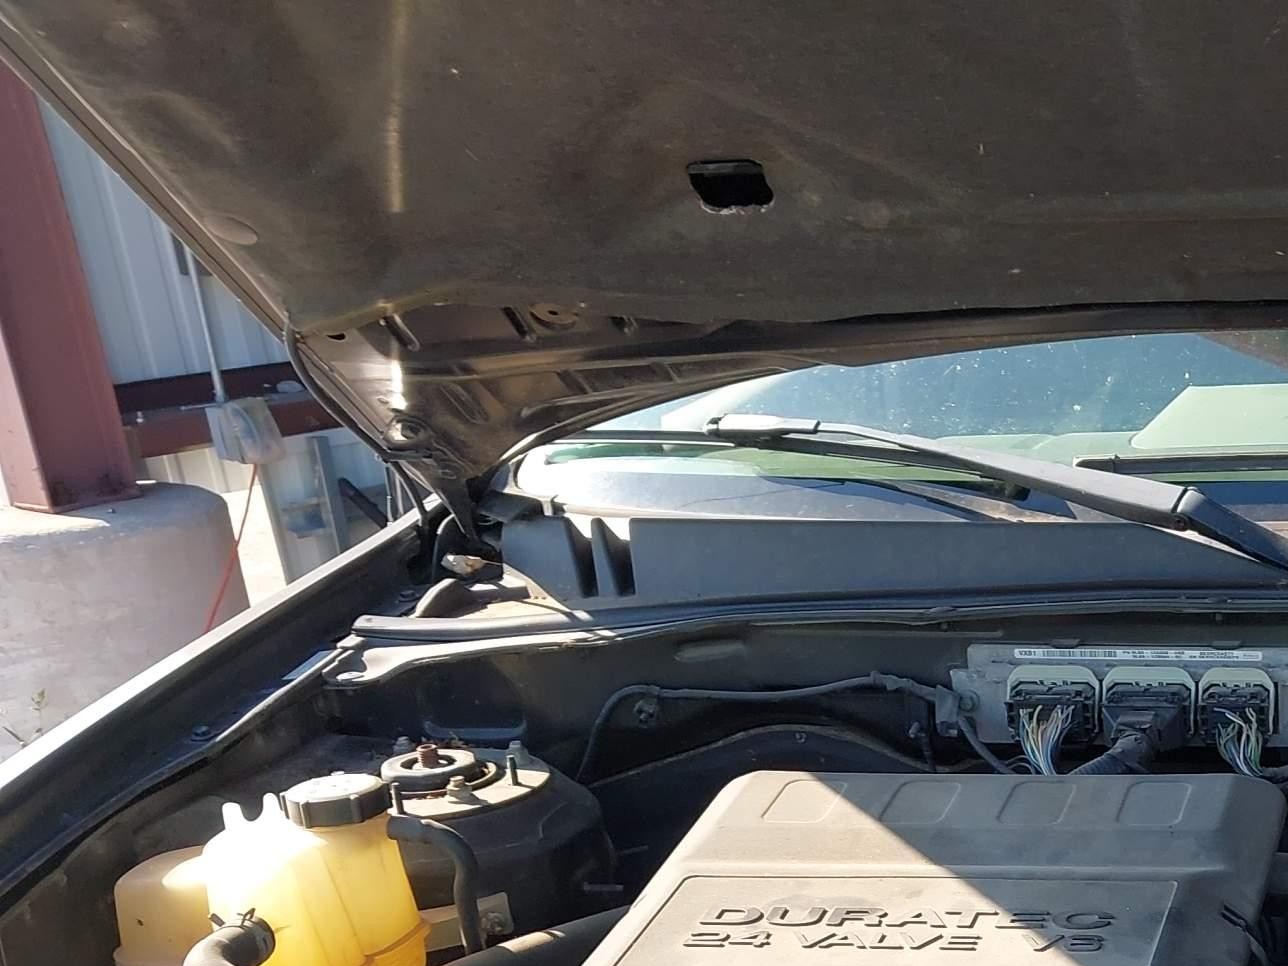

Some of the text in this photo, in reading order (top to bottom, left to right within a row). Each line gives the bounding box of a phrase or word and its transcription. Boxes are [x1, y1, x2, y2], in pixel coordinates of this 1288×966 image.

[698, 905, 1116, 929] DURATEC
[683, 930, 1109, 953] 24 VALVE V6
